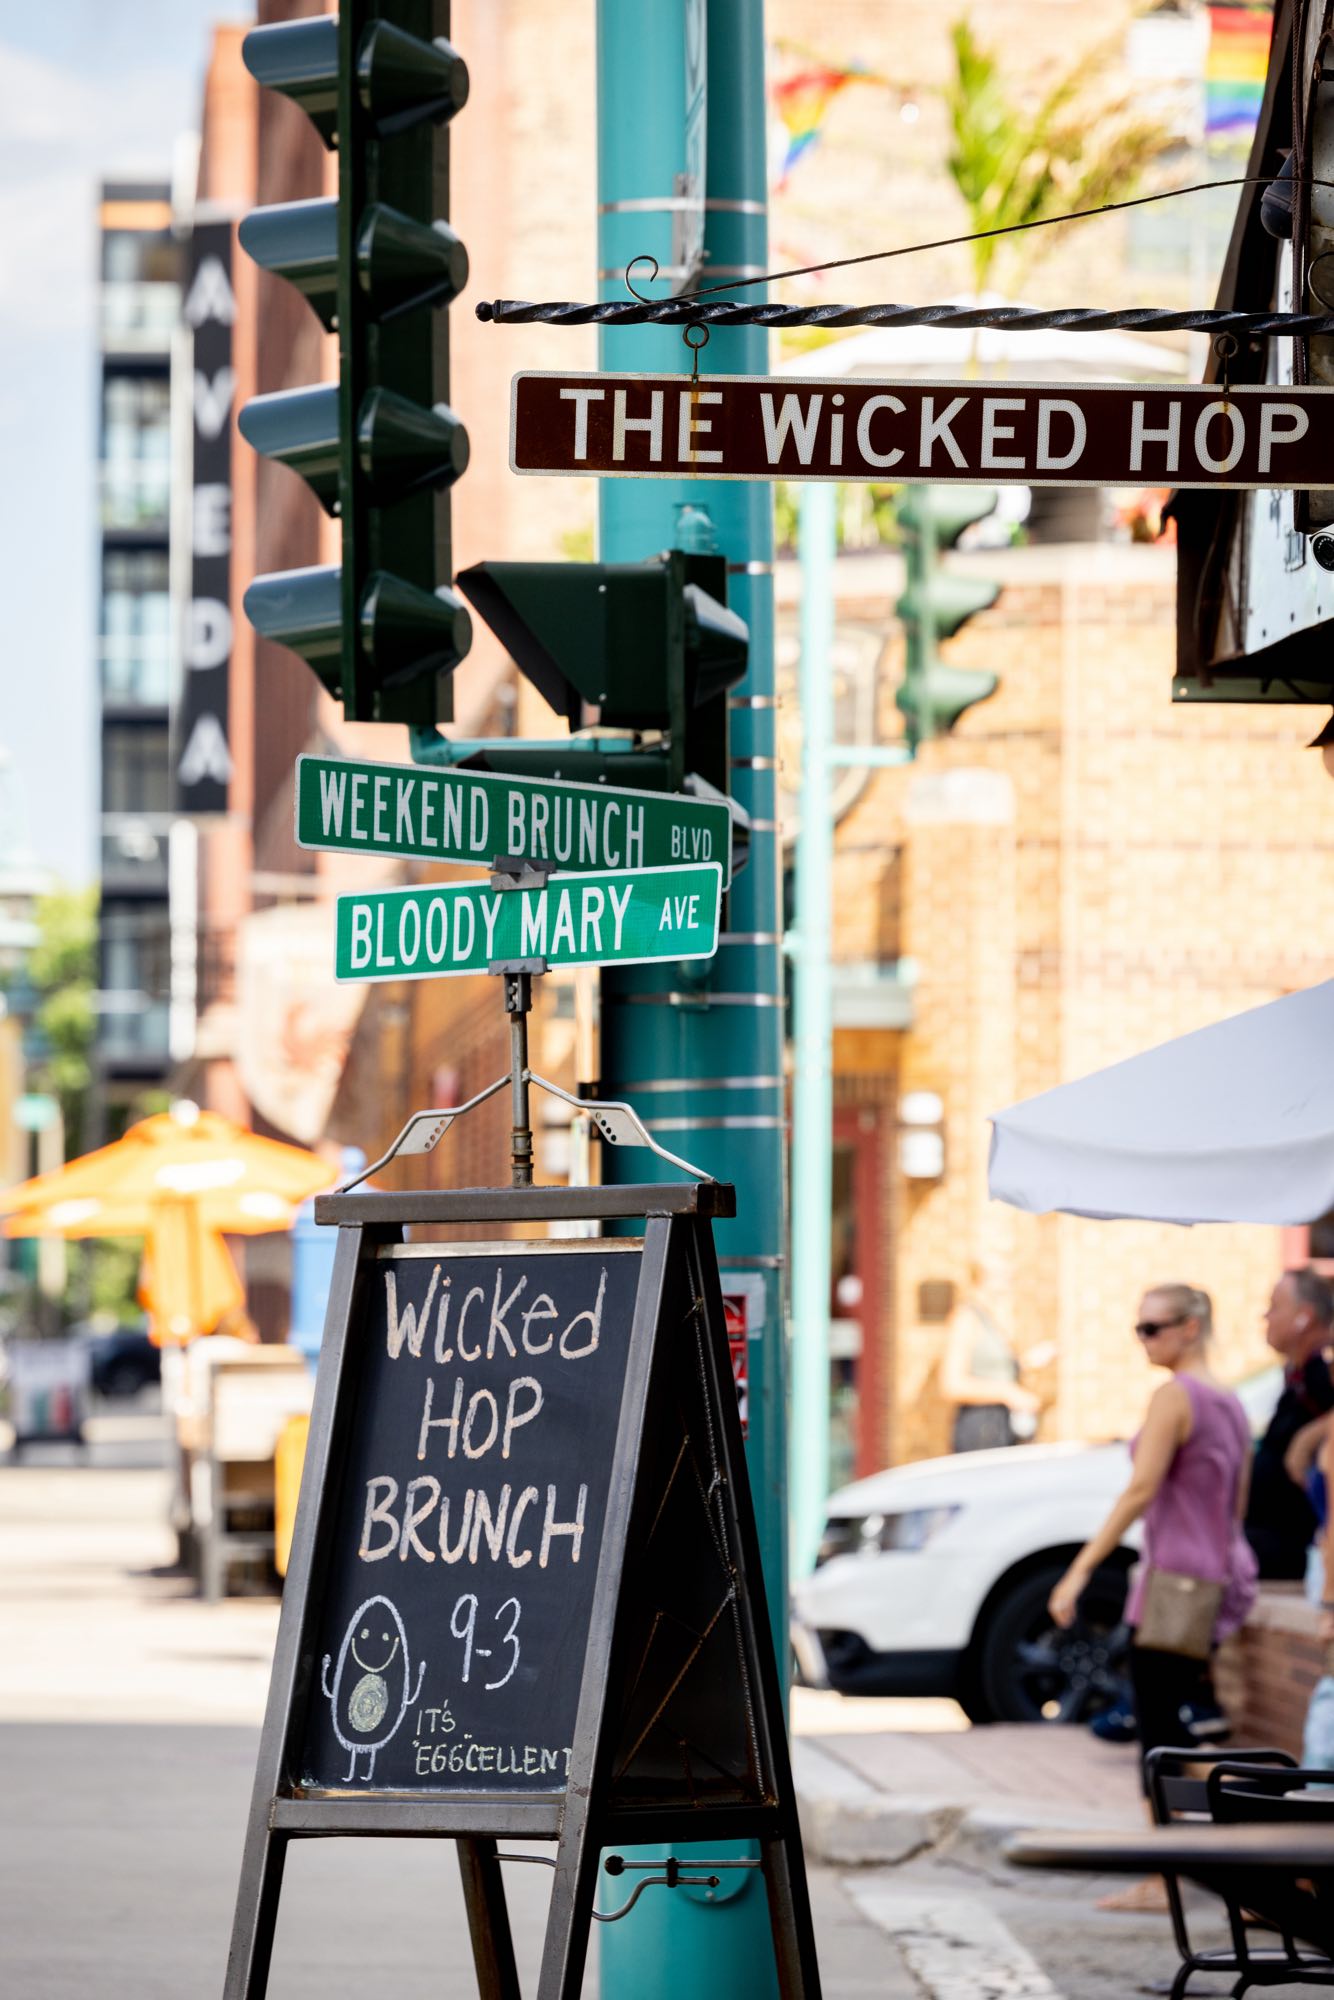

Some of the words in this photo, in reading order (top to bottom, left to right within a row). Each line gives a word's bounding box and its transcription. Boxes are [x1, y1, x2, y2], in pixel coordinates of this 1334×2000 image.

[559, 387, 724, 464] THE
[1129, 400, 1310, 474] HOP
[178, 252, 238, 788] AVEDA
[319, 769, 490, 853] WEEKEND
[507, 791, 645, 869] BRUNCH
[671, 825, 713, 862] BLVD
[350, 893, 504, 970] BLOODY
[520, 883, 634, 957] MARY
[658, 894, 700, 932] AVE
[416, 1375, 545, 1461] HOP
[358, 1474, 589, 1569] BRUNCH
[450, 1593, 522, 1690] 9-3
[415, 1699, 457, 1736] IT'S
